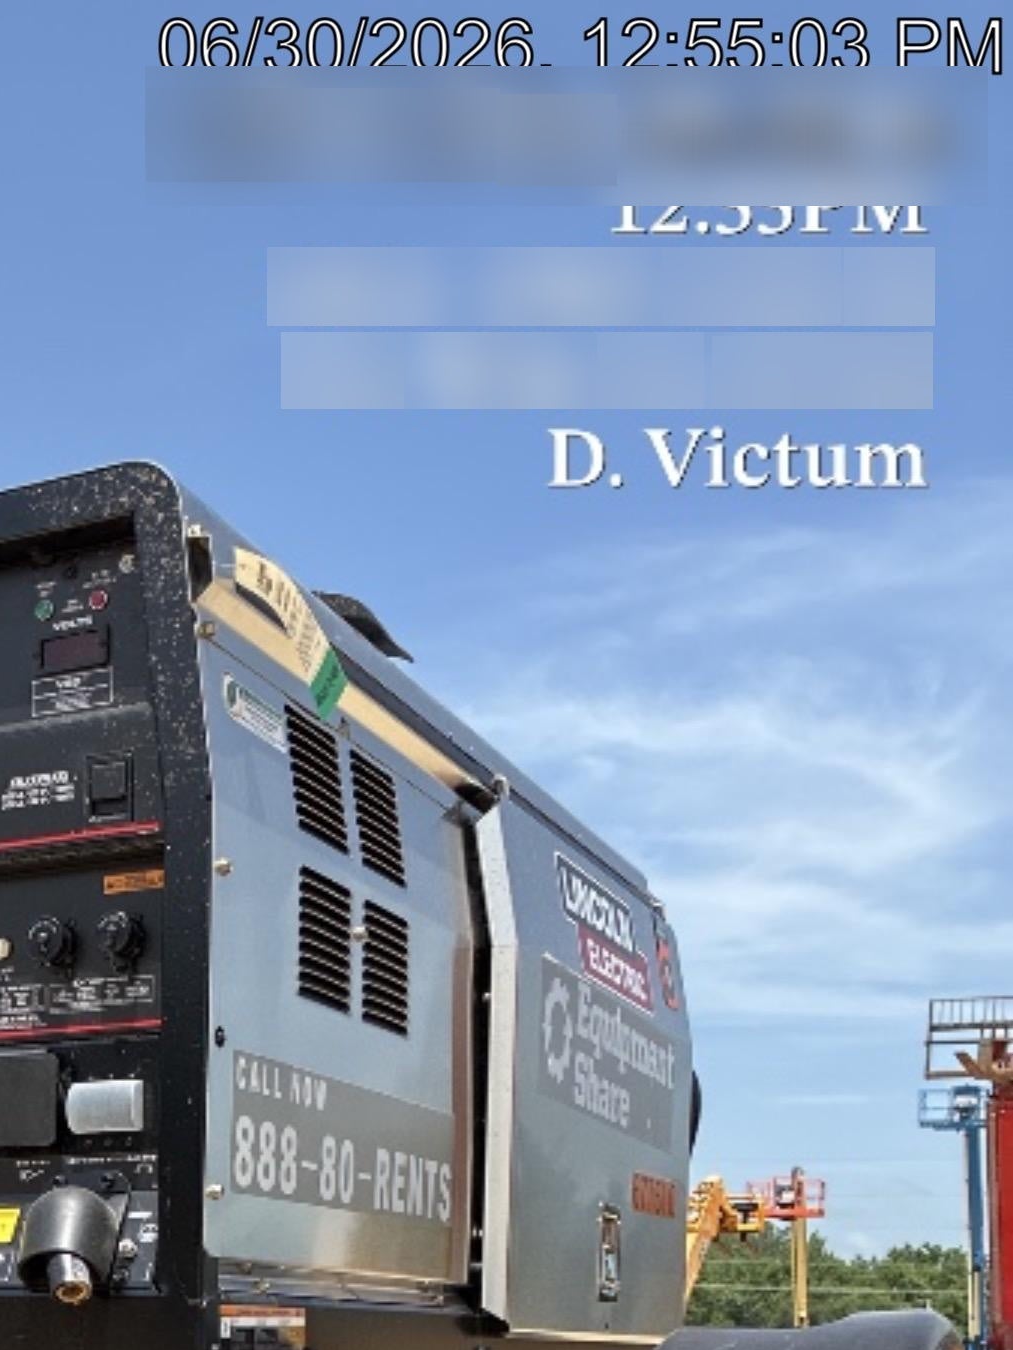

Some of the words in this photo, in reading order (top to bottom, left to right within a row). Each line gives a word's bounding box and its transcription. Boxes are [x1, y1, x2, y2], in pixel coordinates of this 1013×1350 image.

[236, 1056, 282, 1099] CALL
[290, 1073, 328, 1111] NOW
[574, 1052, 631, 1128] Share
[234, 1115, 452, 1223] 888-80-RENTS
